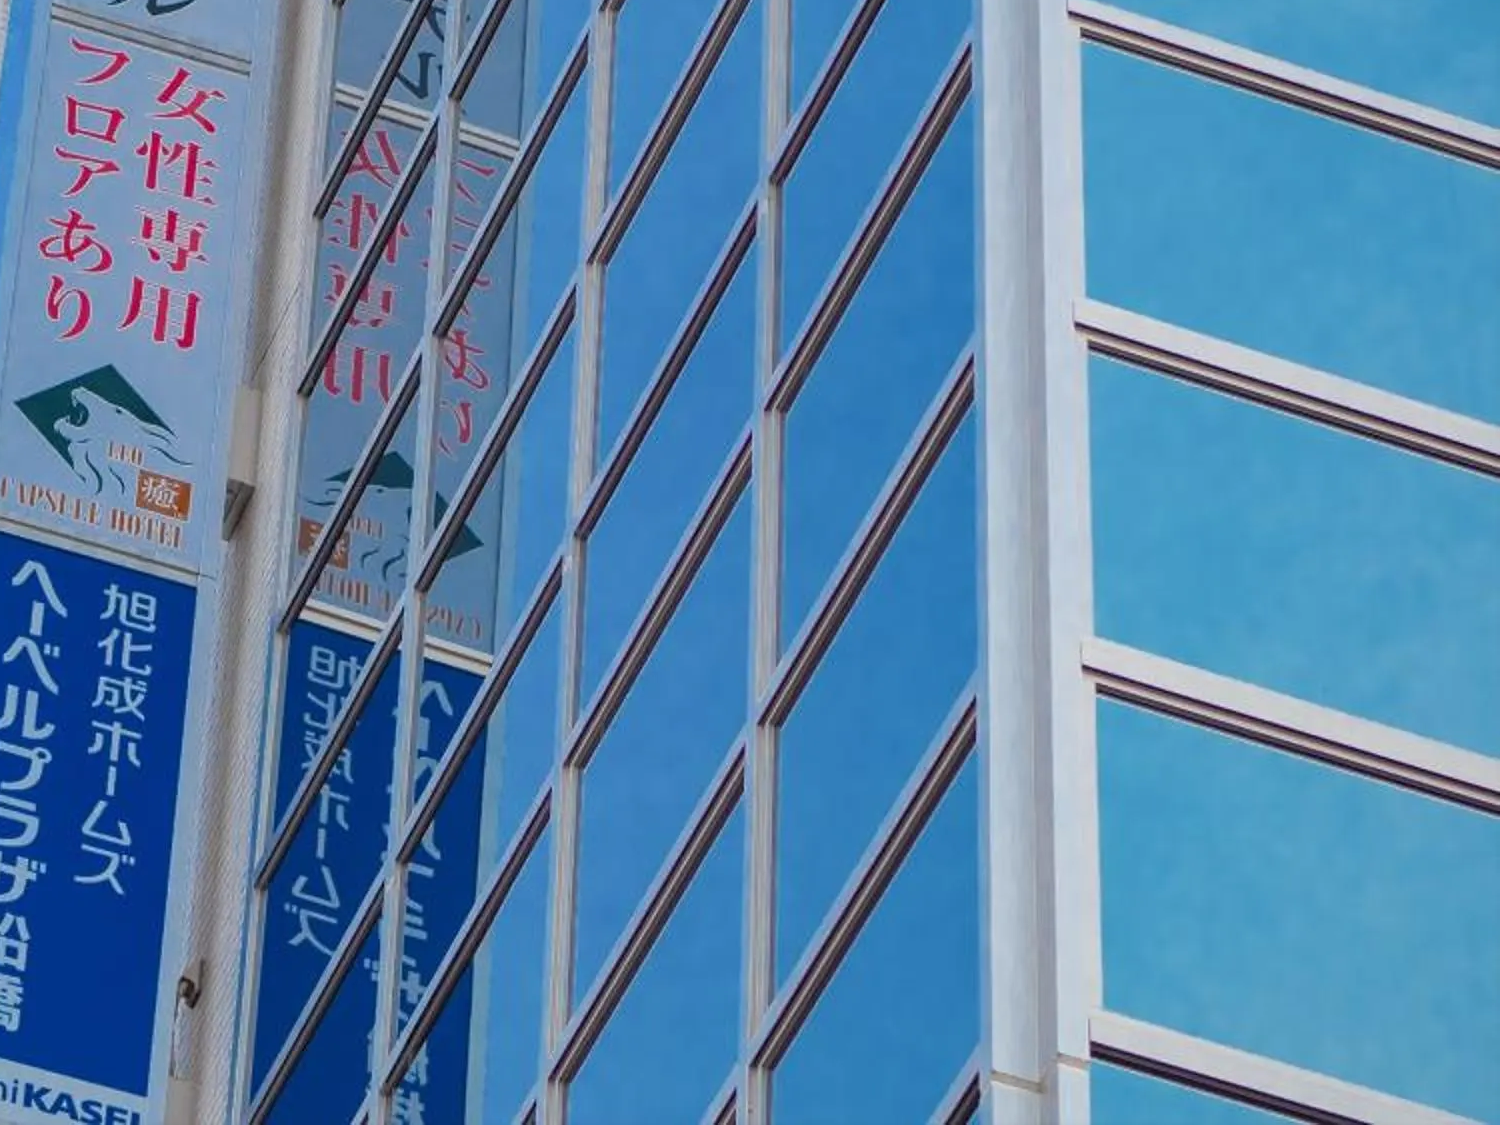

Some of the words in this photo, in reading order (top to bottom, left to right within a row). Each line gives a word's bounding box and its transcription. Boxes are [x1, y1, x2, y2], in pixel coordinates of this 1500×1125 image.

[38, 36, 132, 341] フロアあり
[116, 66, 228, 350] 女性専用
[109, 507, 182, 550] HOTEL
[73, 582, 158, 895] 旭化成ホームズ
